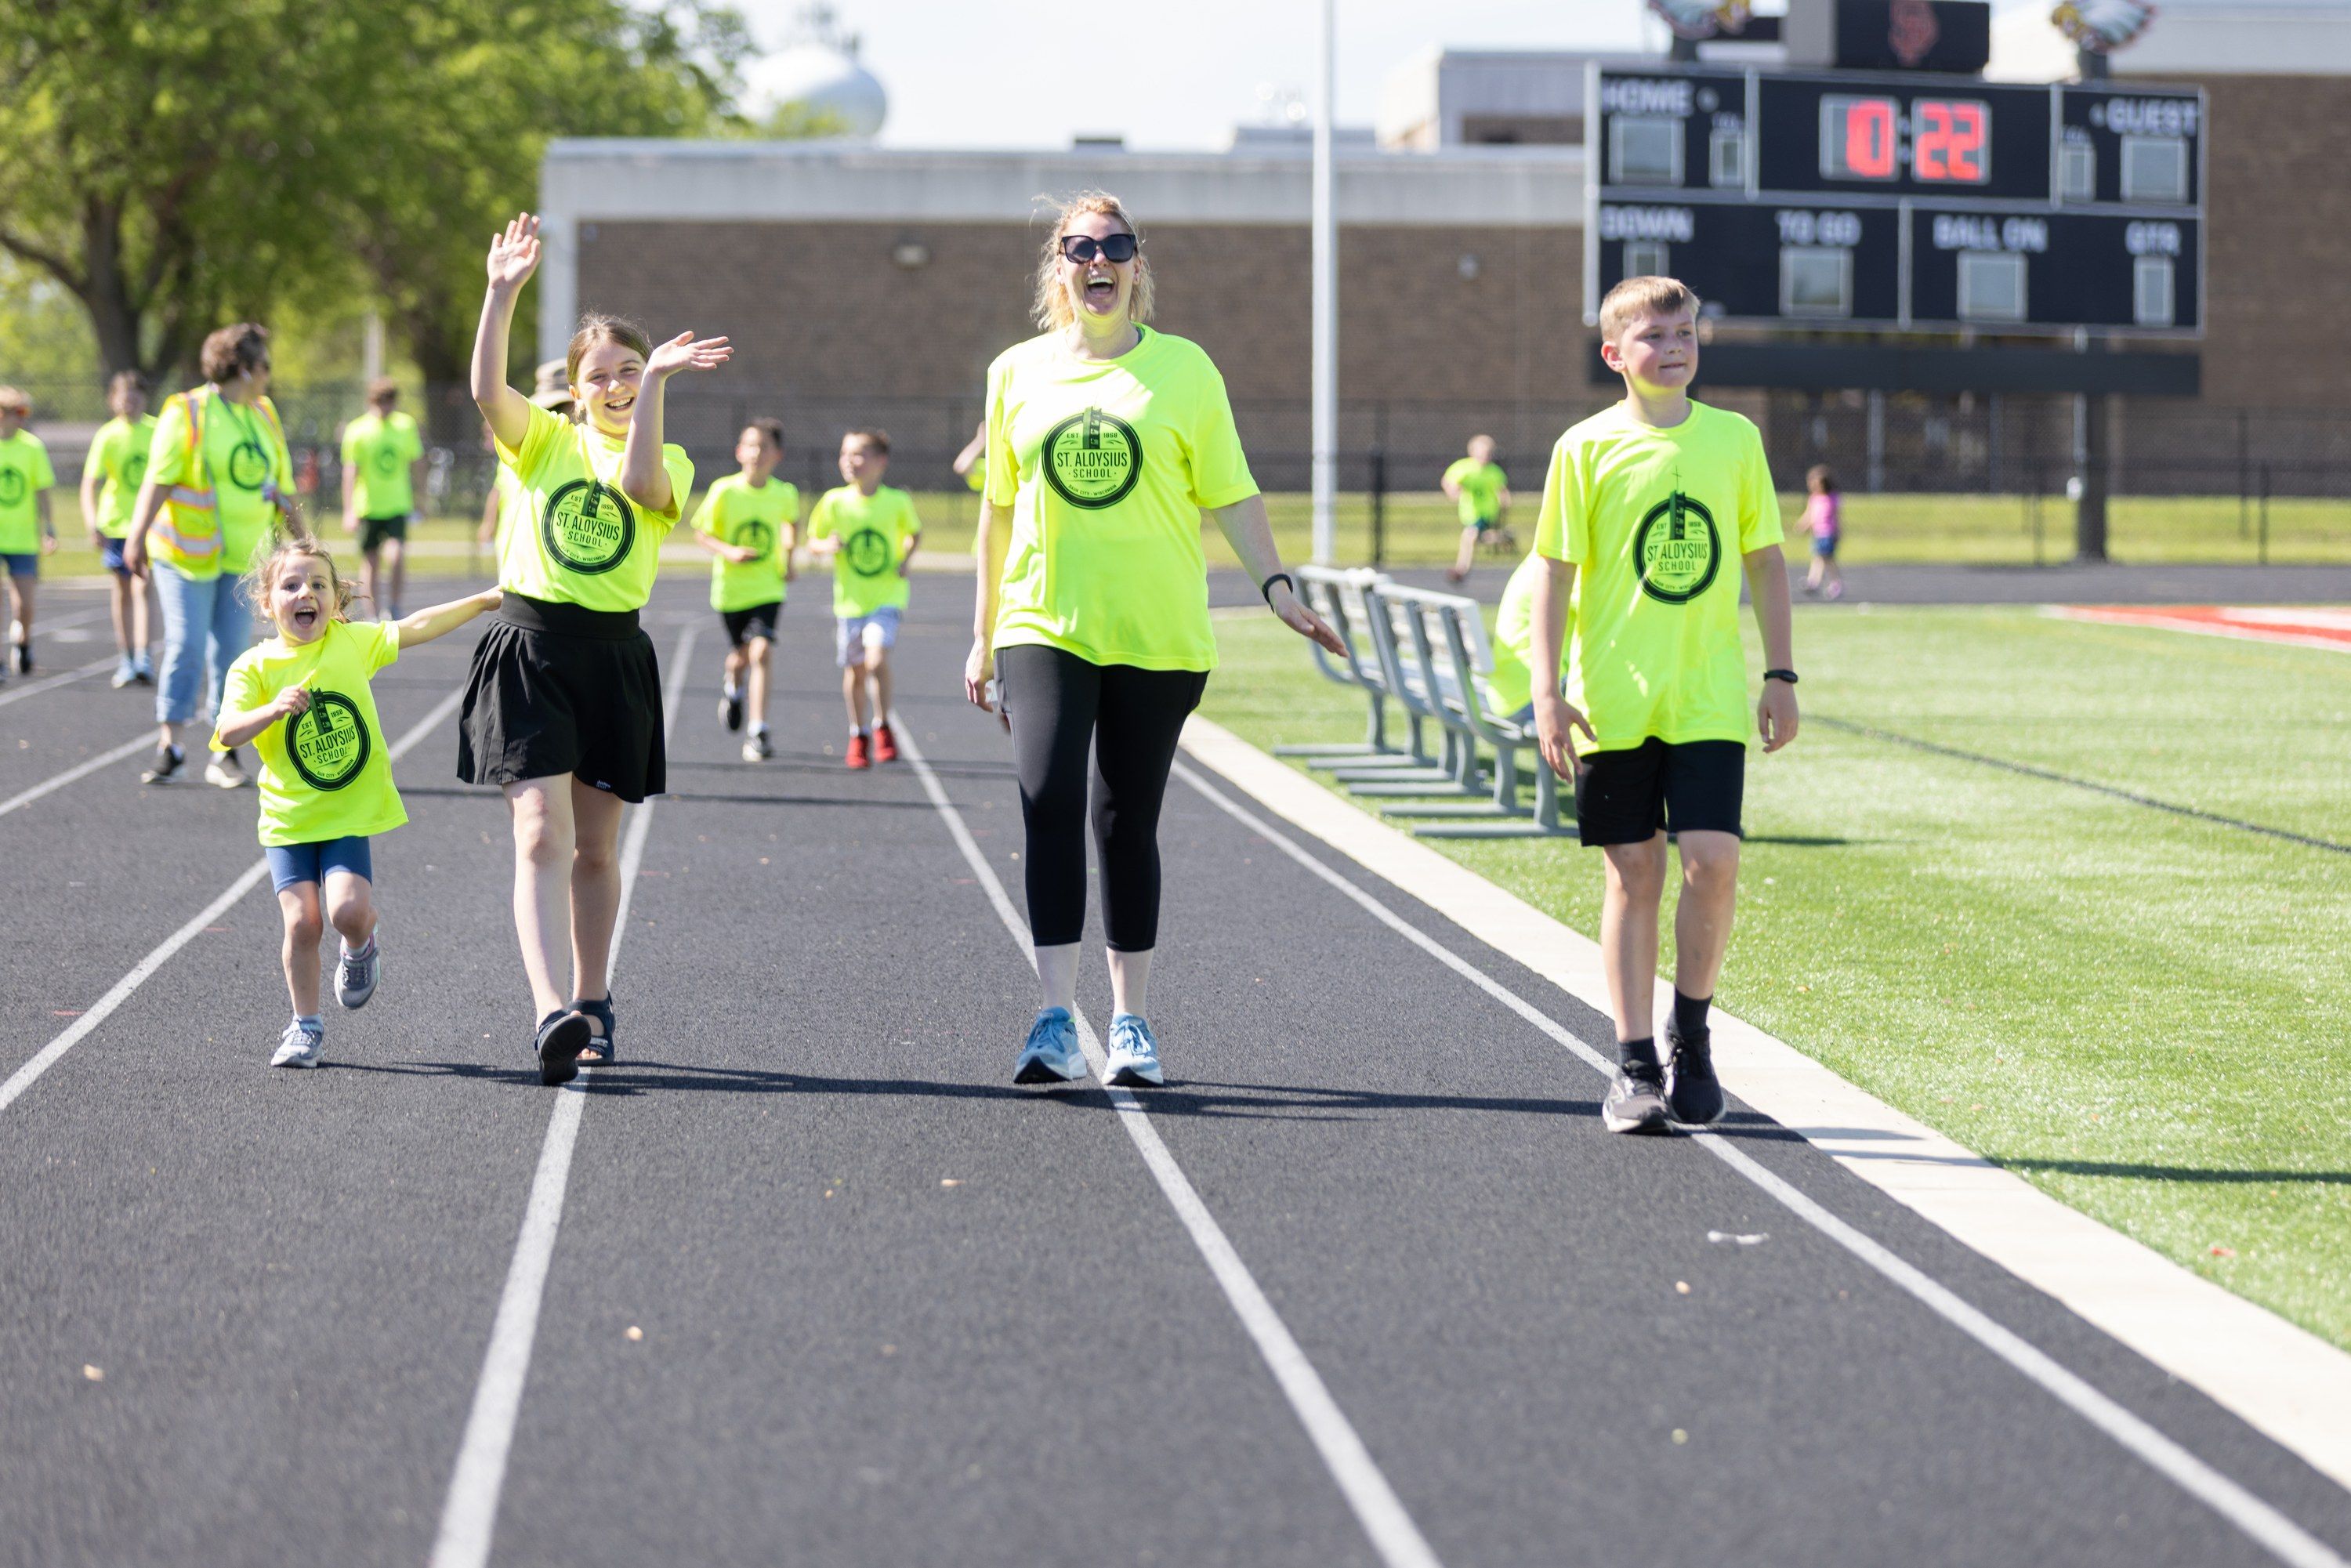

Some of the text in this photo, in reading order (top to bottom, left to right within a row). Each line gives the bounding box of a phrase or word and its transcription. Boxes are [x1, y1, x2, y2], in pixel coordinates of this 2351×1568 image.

[1602, 79, 1694, 116] HOME
[2106, 97, 2197, 136] GUEST
[1846, 100, 1985, 181] 0:22
[1601, 205, 1694, 242] DOWN
[1775, 209, 1862, 246] TO GO
[1933, 214, 2048, 252] BALL ON
[2125, 220, 2182, 256] QTR
[1056, 452, 1128, 467] ST. ALOYSIUS
[1073, 469, 1112, 479] SCHOOL
[556, 512, 620, 541] ST. ALOYSIUS
[567, 531, 603, 548] SCHOOL
[1658, 560, 1696, 572] SCHOOL
[1661, 542, 1708, 559] ALOYSIUS
[302, 721, 313, 730] EST
[299, 725, 356, 759] ST. ALOYSIUS
[317, 746, 347, 764] SCHOOL
